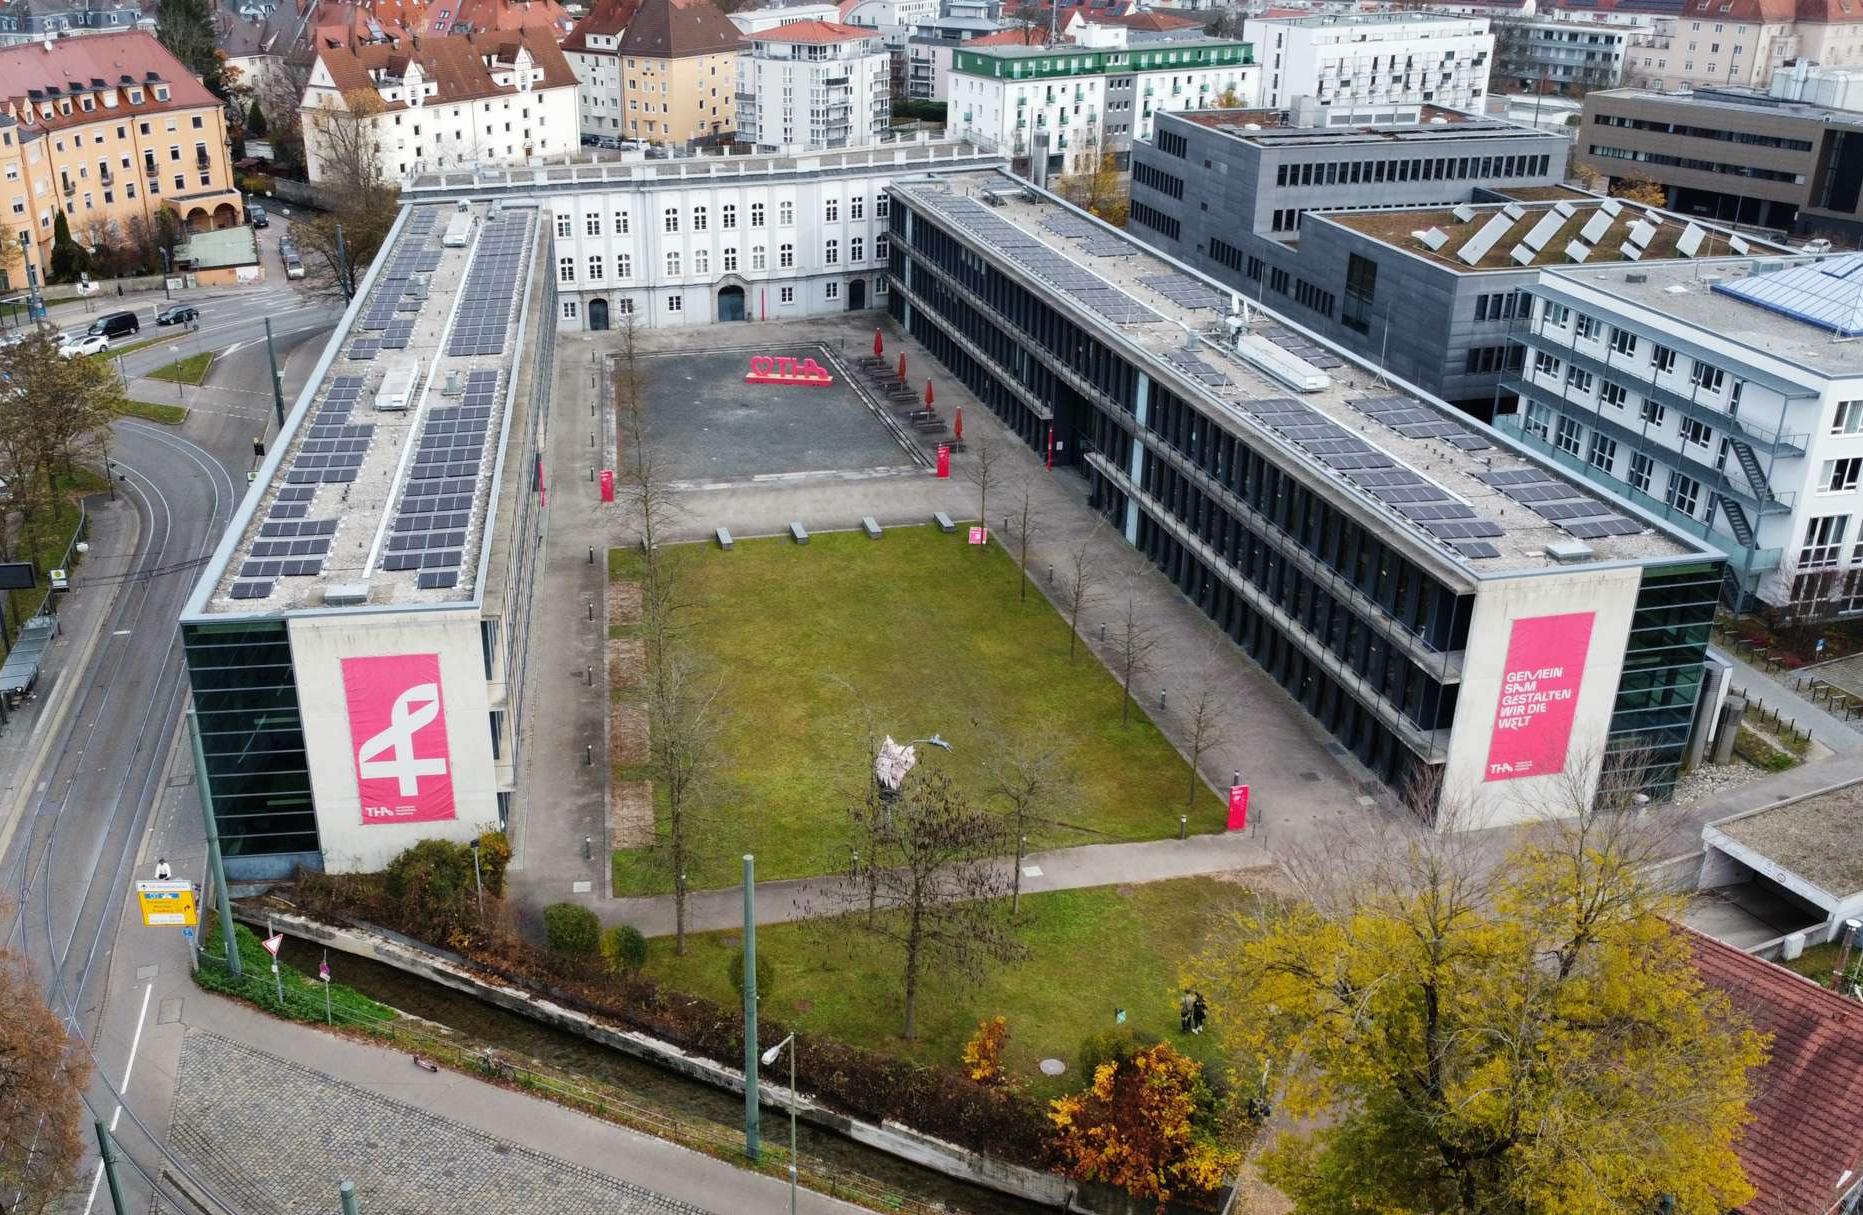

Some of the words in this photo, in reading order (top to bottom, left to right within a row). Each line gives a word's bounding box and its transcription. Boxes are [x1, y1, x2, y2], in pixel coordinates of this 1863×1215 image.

[1507, 667, 1563, 682] GEMEIN
[1504, 681, 1537, 694] SAM
[1502, 689, 1572, 705] GESTALTEN
[1500, 705, 1525, 718] WIR
[1527, 703, 1547, 714] DIE
[1498, 716, 1531, 730] WELT
